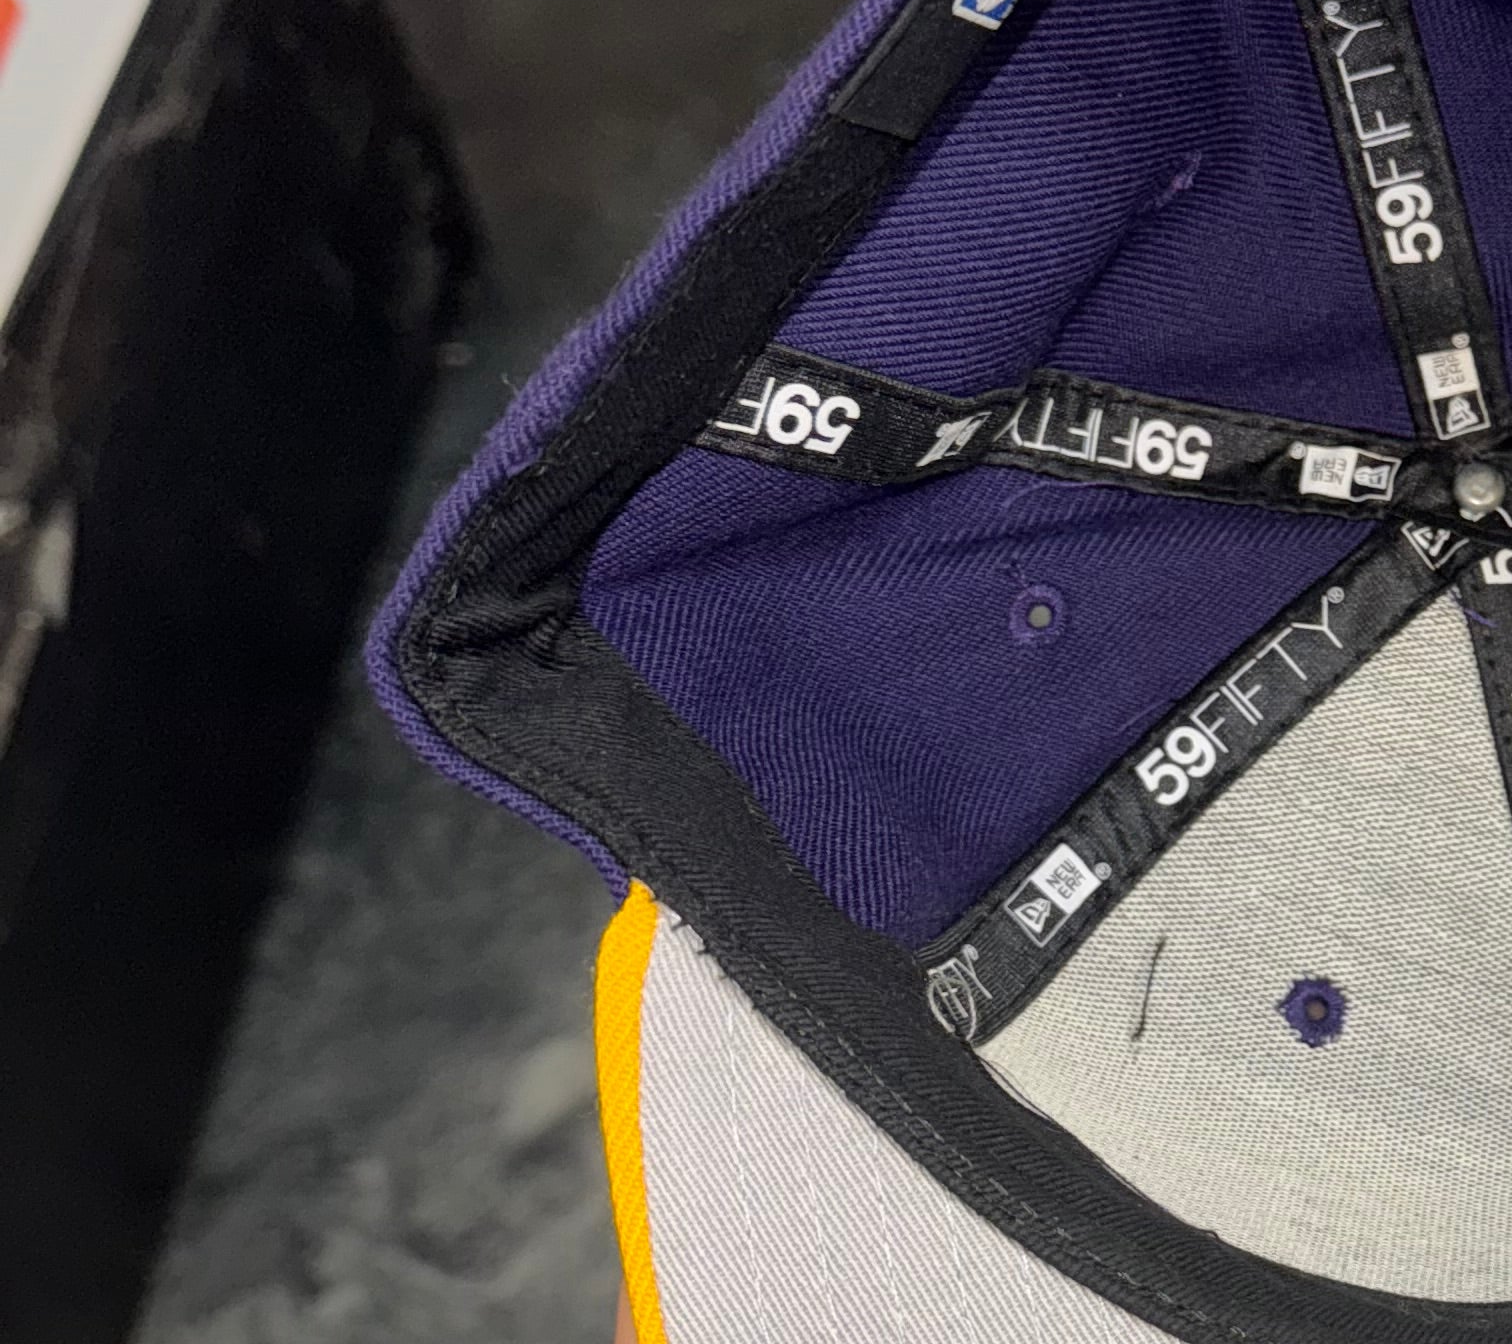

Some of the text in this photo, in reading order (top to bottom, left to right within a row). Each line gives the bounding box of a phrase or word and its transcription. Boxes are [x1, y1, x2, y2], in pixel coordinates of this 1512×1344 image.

[1325, 13, 1444, 264] 59FIFTY
[1431, 356, 1450, 388] NEW
[1446, 354, 1465, 385] ERA
[993, 397, 1213, 480] 59FIFTY
[1311, 470, 1344, 485] NEW
[1313, 458, 1347, 471] ERA
[1136, 595, 1343, 805] 59FIFTY
[1045, 858, 1077, 889] NEW
[1057, 870, 1086, 899] ERA
